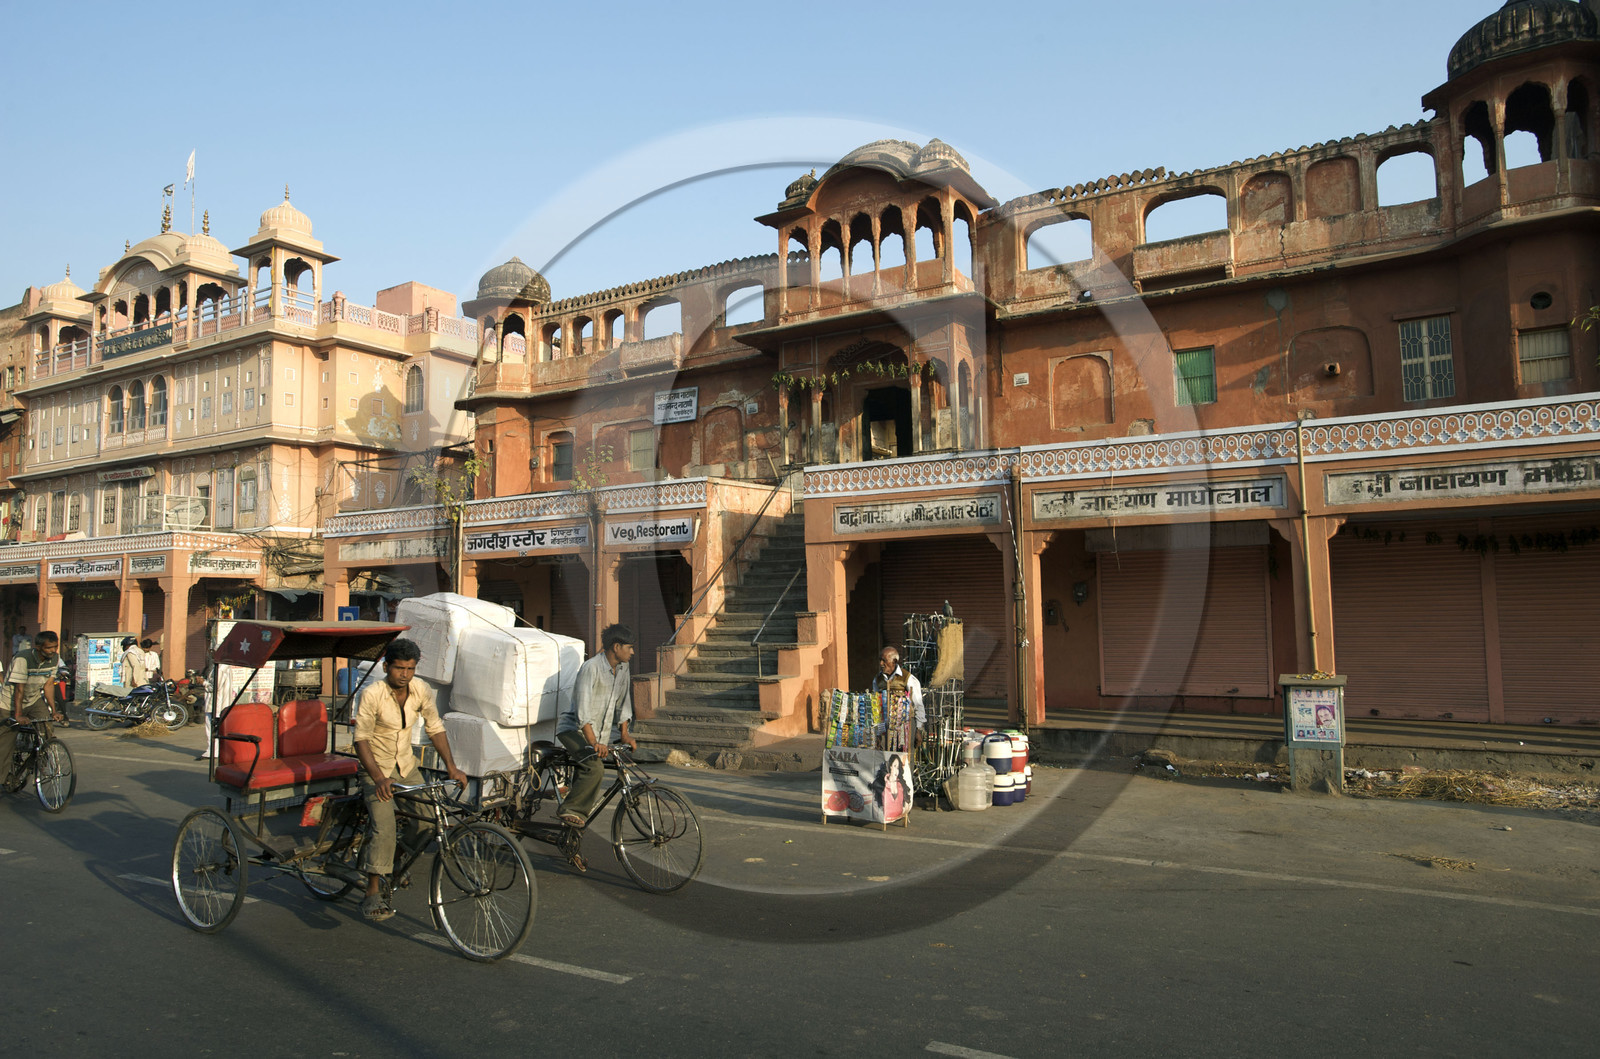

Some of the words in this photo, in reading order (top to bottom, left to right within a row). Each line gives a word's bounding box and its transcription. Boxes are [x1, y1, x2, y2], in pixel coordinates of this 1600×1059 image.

[467, 533, 511, 551] जगदीश
[512, 530, 547, 547] स्टोर
[53, 564, 75, 576] मित्तल
[96, 560, 119, 573] कम्पनी
